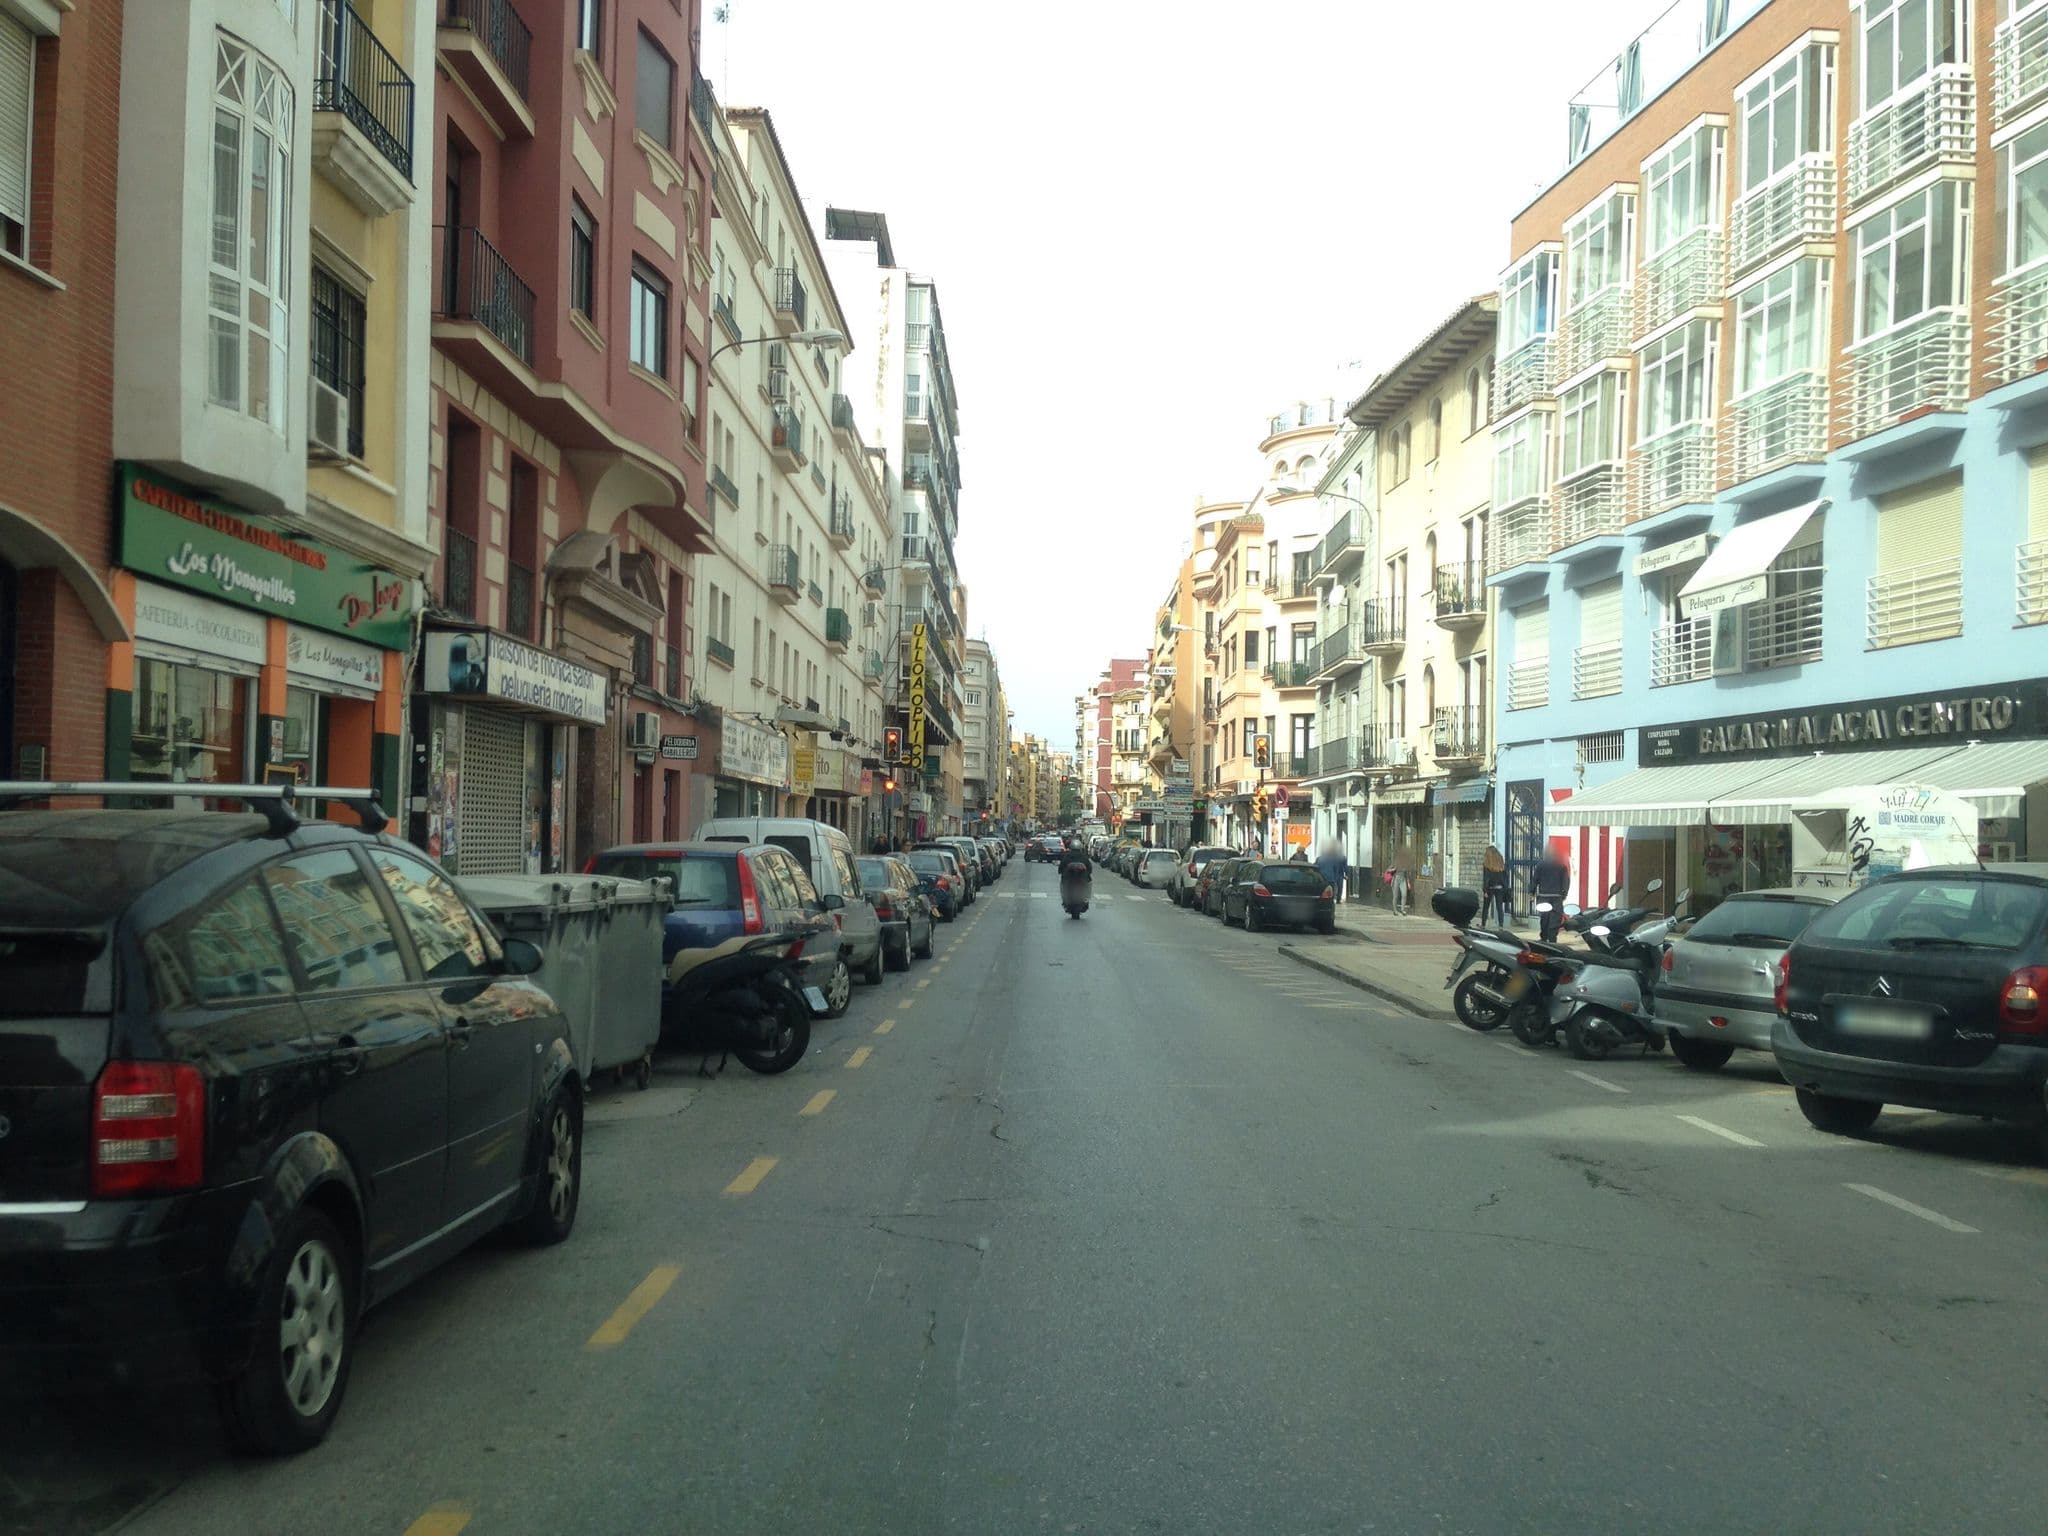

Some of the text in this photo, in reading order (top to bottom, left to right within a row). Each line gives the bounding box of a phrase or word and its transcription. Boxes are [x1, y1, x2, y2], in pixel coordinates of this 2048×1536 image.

[168, 542, 296, 606] Los Monaguillos
[306, 641, 321, 662] Los
[490, 638, 526, 669] maison
[527, 648, 539, 673] de
[911, 624, 925, 769] ULLOA OPTICO
[1699, 695, 2013, 753] BAZAR MALAGA CENTRO
[664, 736, 695, 747] PELUQUERIA
[1647, 729, 1680, 738] COMPLEMENTOS
[663, 747, 696, 757] CABALLEROS
[1654, 748, 1673, 756] CALZADO
[1893, 813, 1946, 825] MADRE CORAJE
